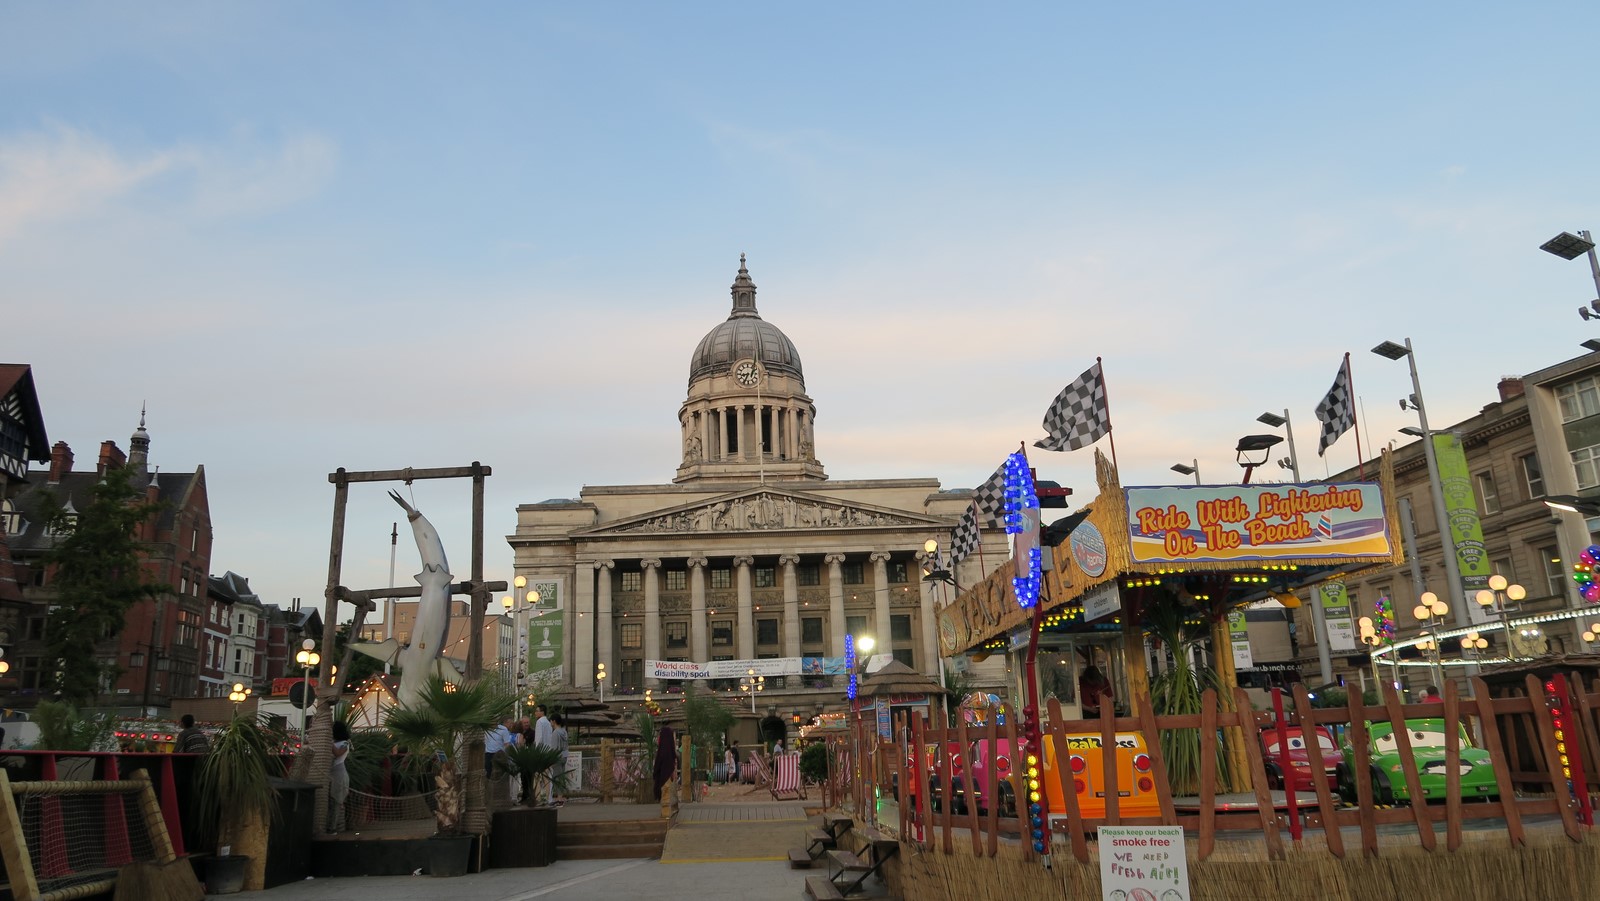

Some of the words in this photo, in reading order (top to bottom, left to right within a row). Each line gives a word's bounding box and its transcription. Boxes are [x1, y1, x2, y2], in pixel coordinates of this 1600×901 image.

[1136, 505, 1190, 534] Ride
[1197, 497, 1250, 526] With
[1256, 486, 1363, 520] Lightening
[1165, 530, 1197, 556] On
[1200, 523, 1241, 552] The
[1245, 514, 1312, 546] Beach
[655, 662, 677, 670] World
[655, 670, 688, 678] disability
[690, 670, 710, 678] sport
[1113, 838, 1147, 846] smoke
[1150, 838, 1170, 846] free
[1114, 853, 1133, 862] WE
